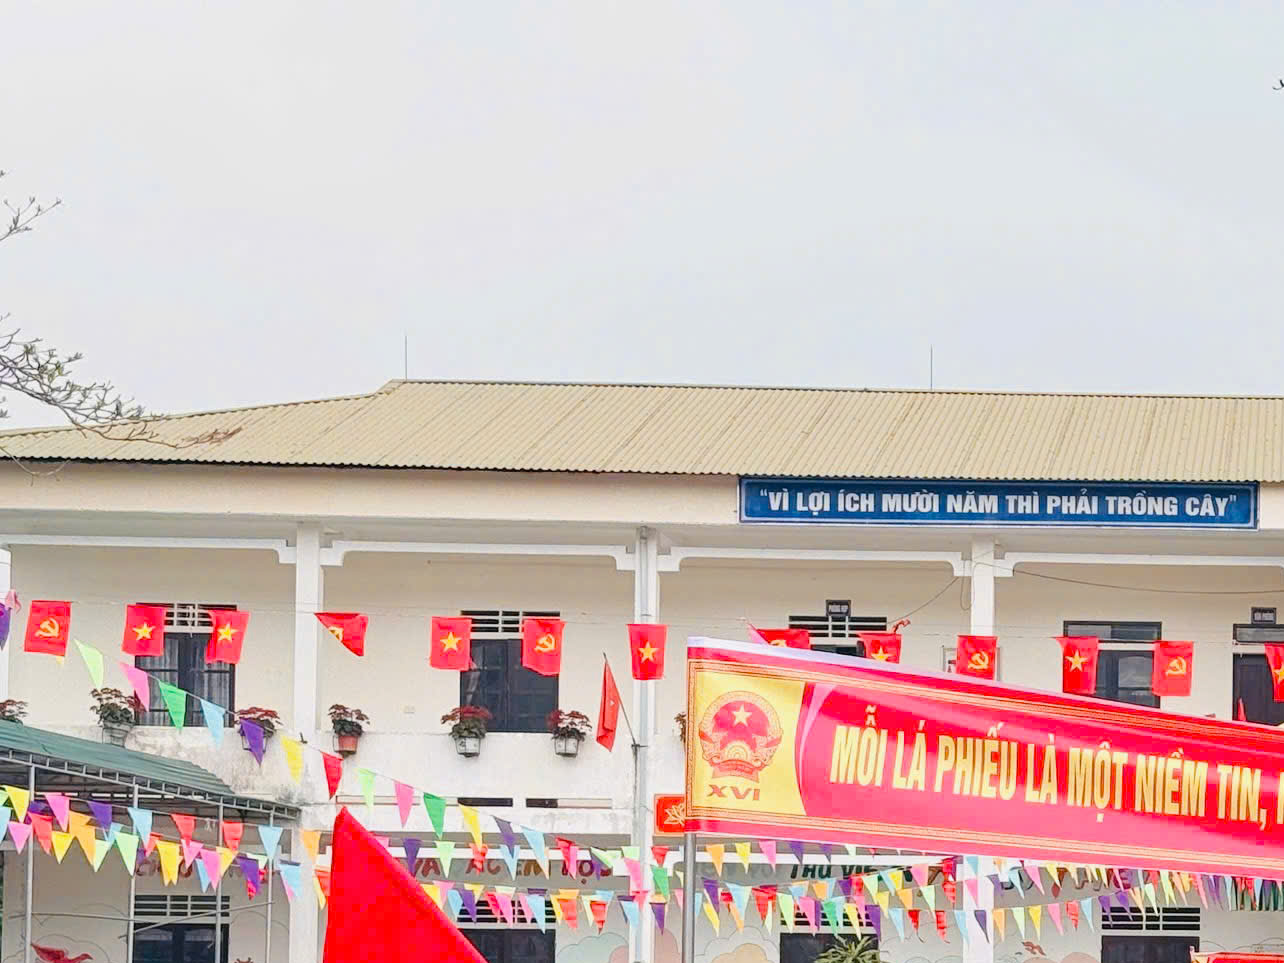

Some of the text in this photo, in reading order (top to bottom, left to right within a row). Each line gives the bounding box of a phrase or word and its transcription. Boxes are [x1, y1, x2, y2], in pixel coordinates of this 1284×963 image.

[797, 490, 830, 516] LỢI
[838, 488, 875, 513] ÍCH
[882, 489, 940, 513] MƯỜI
[947, 490, 999, 514] NĂM
[1005, 491, 1040, 515] THÌ
[1046, 488, 1099, 515] PHẢI
[1105, 490, 1179, 517] TRỒNG
[829, 704, 889, 787] MỖI
[892, 719, 927, 792] LÁ
[933, 721, 1019, 801] PHIẾU
[1025, 733, 1058, 805] LÀ
[1067, 741, 1129, 823] MỘT
[1134, 748, 1209, 818] NIỀM
[1217, 763, 1268, 831] TIN,
[706, 783, 761, 801] XVI
